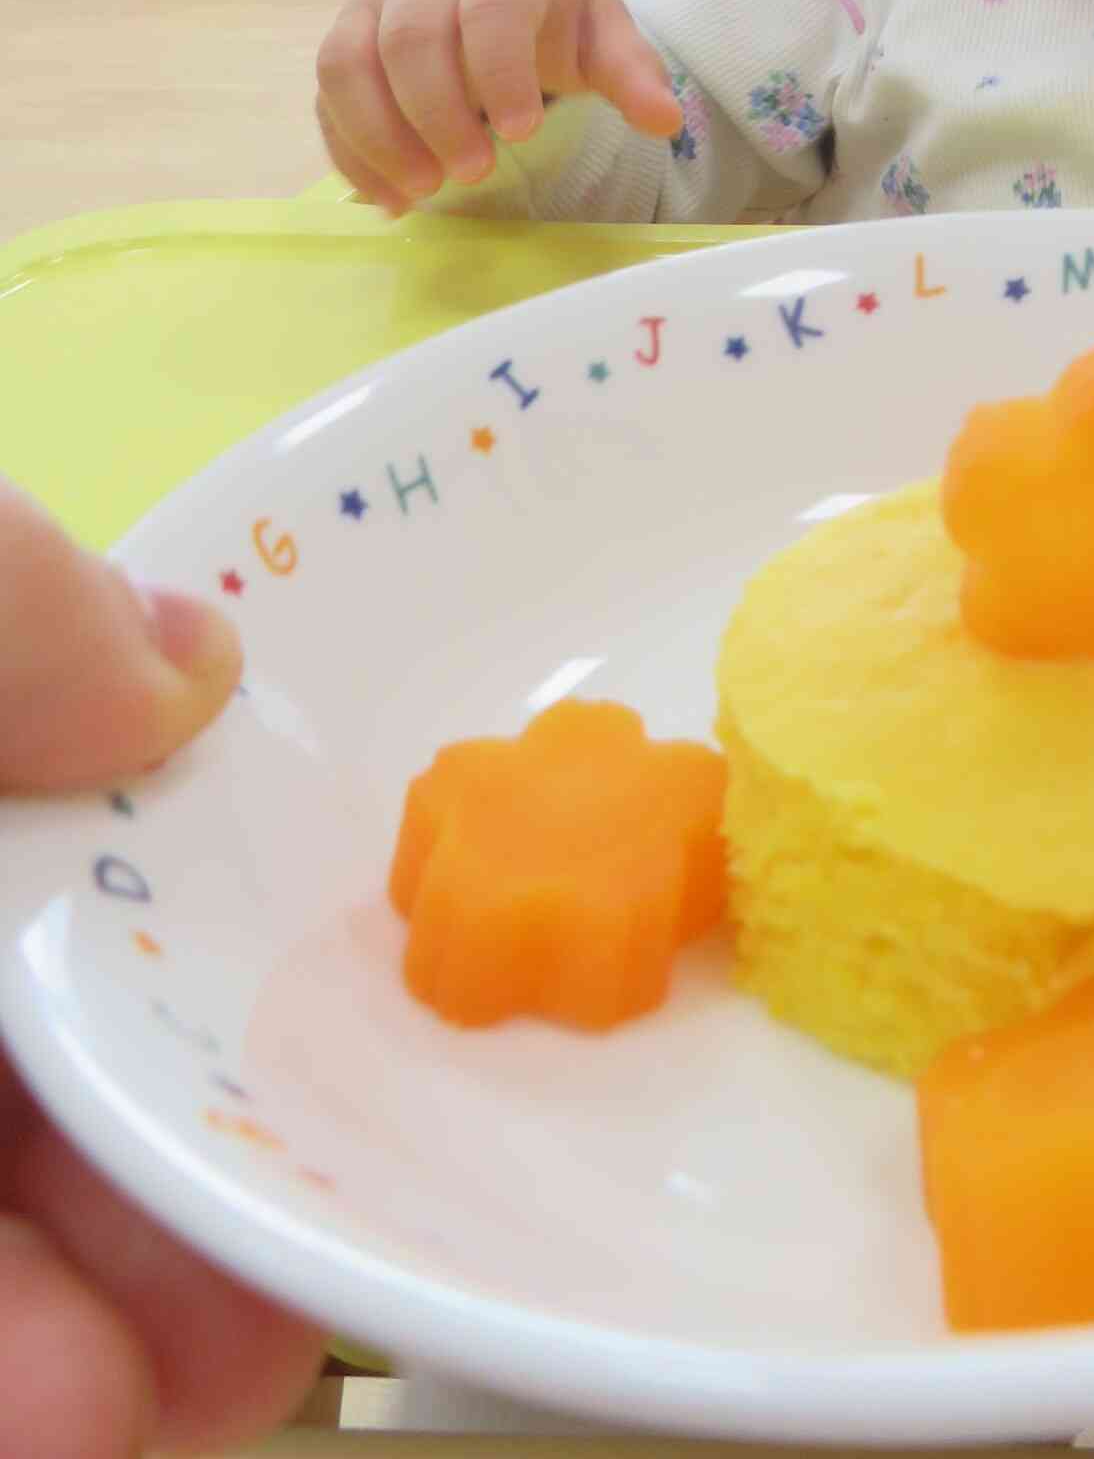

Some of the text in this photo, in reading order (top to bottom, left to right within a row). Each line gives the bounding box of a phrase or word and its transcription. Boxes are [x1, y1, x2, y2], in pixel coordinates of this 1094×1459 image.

[251, 518, 299, 577] G
[387, 455, 438, 516] H
[489, 360, 539, 410] I
[635, 316, 666, 367] J
[779, 297, 824, 349] K
[914, 252, 947, 300] L
